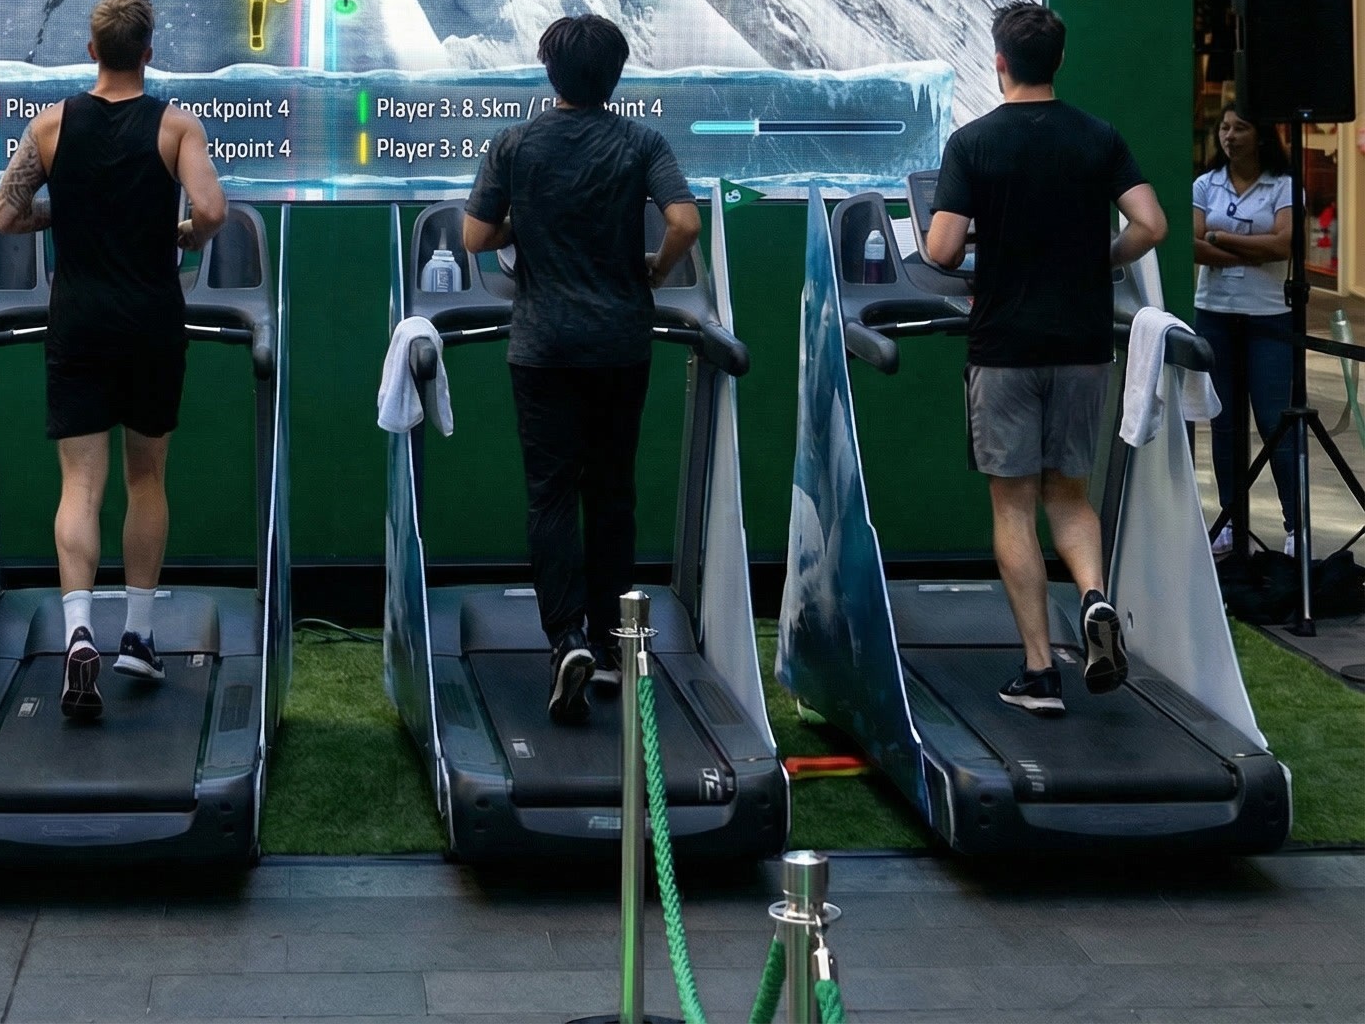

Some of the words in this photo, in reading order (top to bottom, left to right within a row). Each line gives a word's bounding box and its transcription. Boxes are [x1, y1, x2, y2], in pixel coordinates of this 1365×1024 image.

[277, 99, 290, 117] 4
[377, 97, 436, 123] Player
[650, 98, 664, 118] 4
[278, 139, 291, 158] 4
[377, 138, 436, 164] Player
[440, 138, 457, 158] 3:
